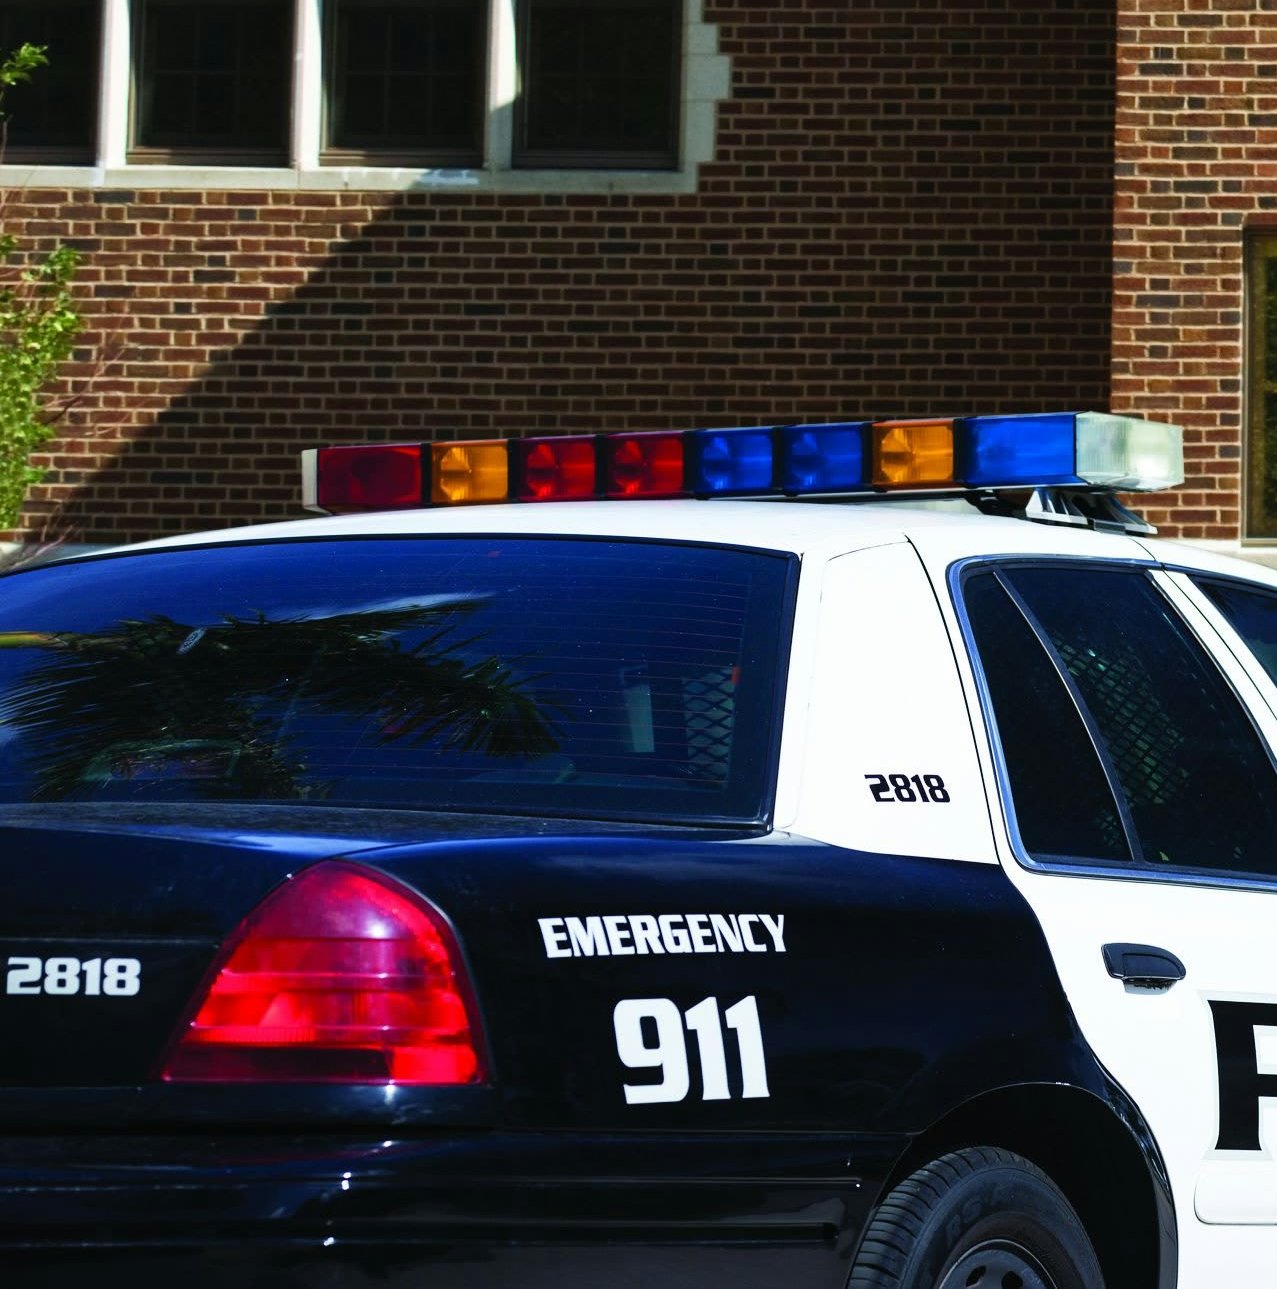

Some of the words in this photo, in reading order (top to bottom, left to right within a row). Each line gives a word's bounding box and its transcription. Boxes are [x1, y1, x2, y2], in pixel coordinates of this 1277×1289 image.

[864, 773, 951, 803] 2818
[537, 913, 787, 959] EMERGENCY
[6, 956, 141, 996] 2818
[613, 995, 770, 1105] 911
